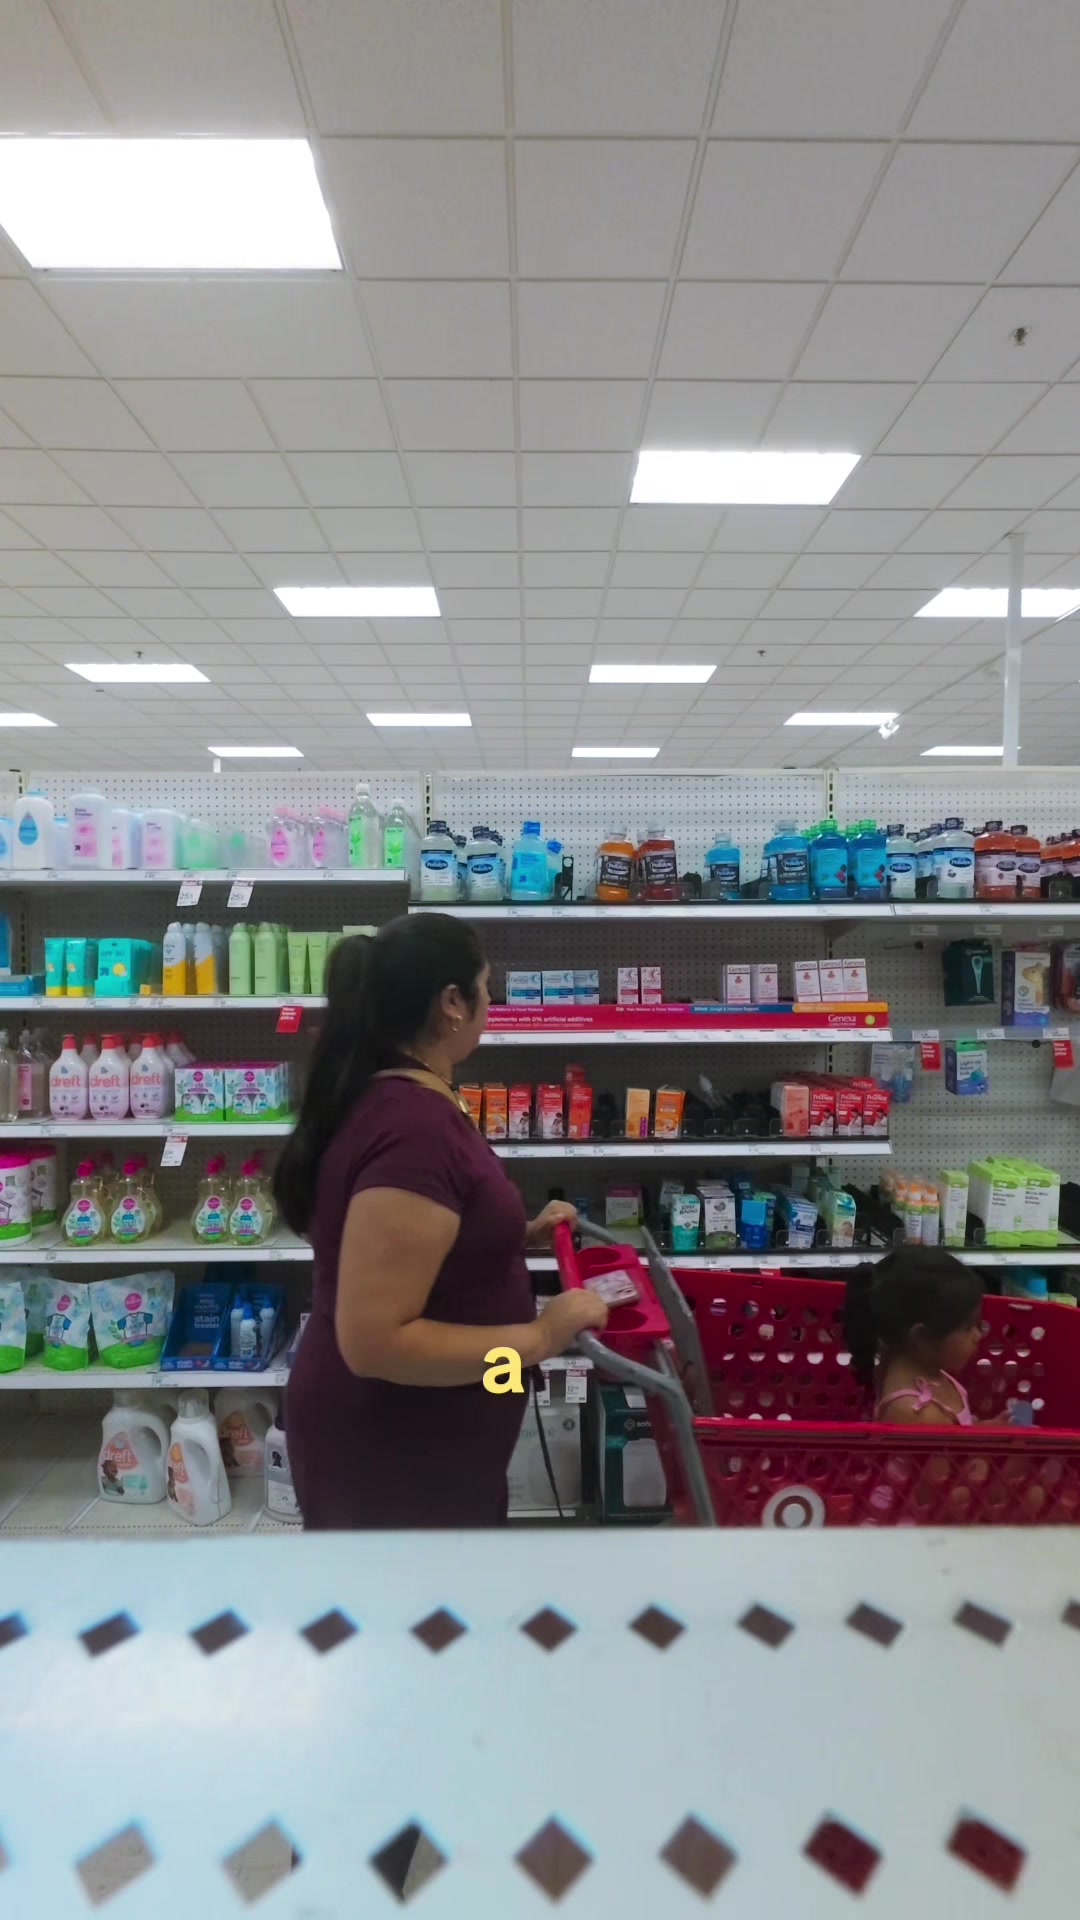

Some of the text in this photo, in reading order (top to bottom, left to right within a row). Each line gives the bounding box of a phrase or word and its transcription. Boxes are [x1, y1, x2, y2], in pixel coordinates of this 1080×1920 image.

[828, 1014, 857, 1023] Genexa
[51, 1075, 81, 1088] dreft
[90, 1075, 120, 1088] dreft
[131, 1072, 161, 1086] dreft
[194, 1315, 220, 1323] stain
[102, 1449, 132, 1464] dreft
